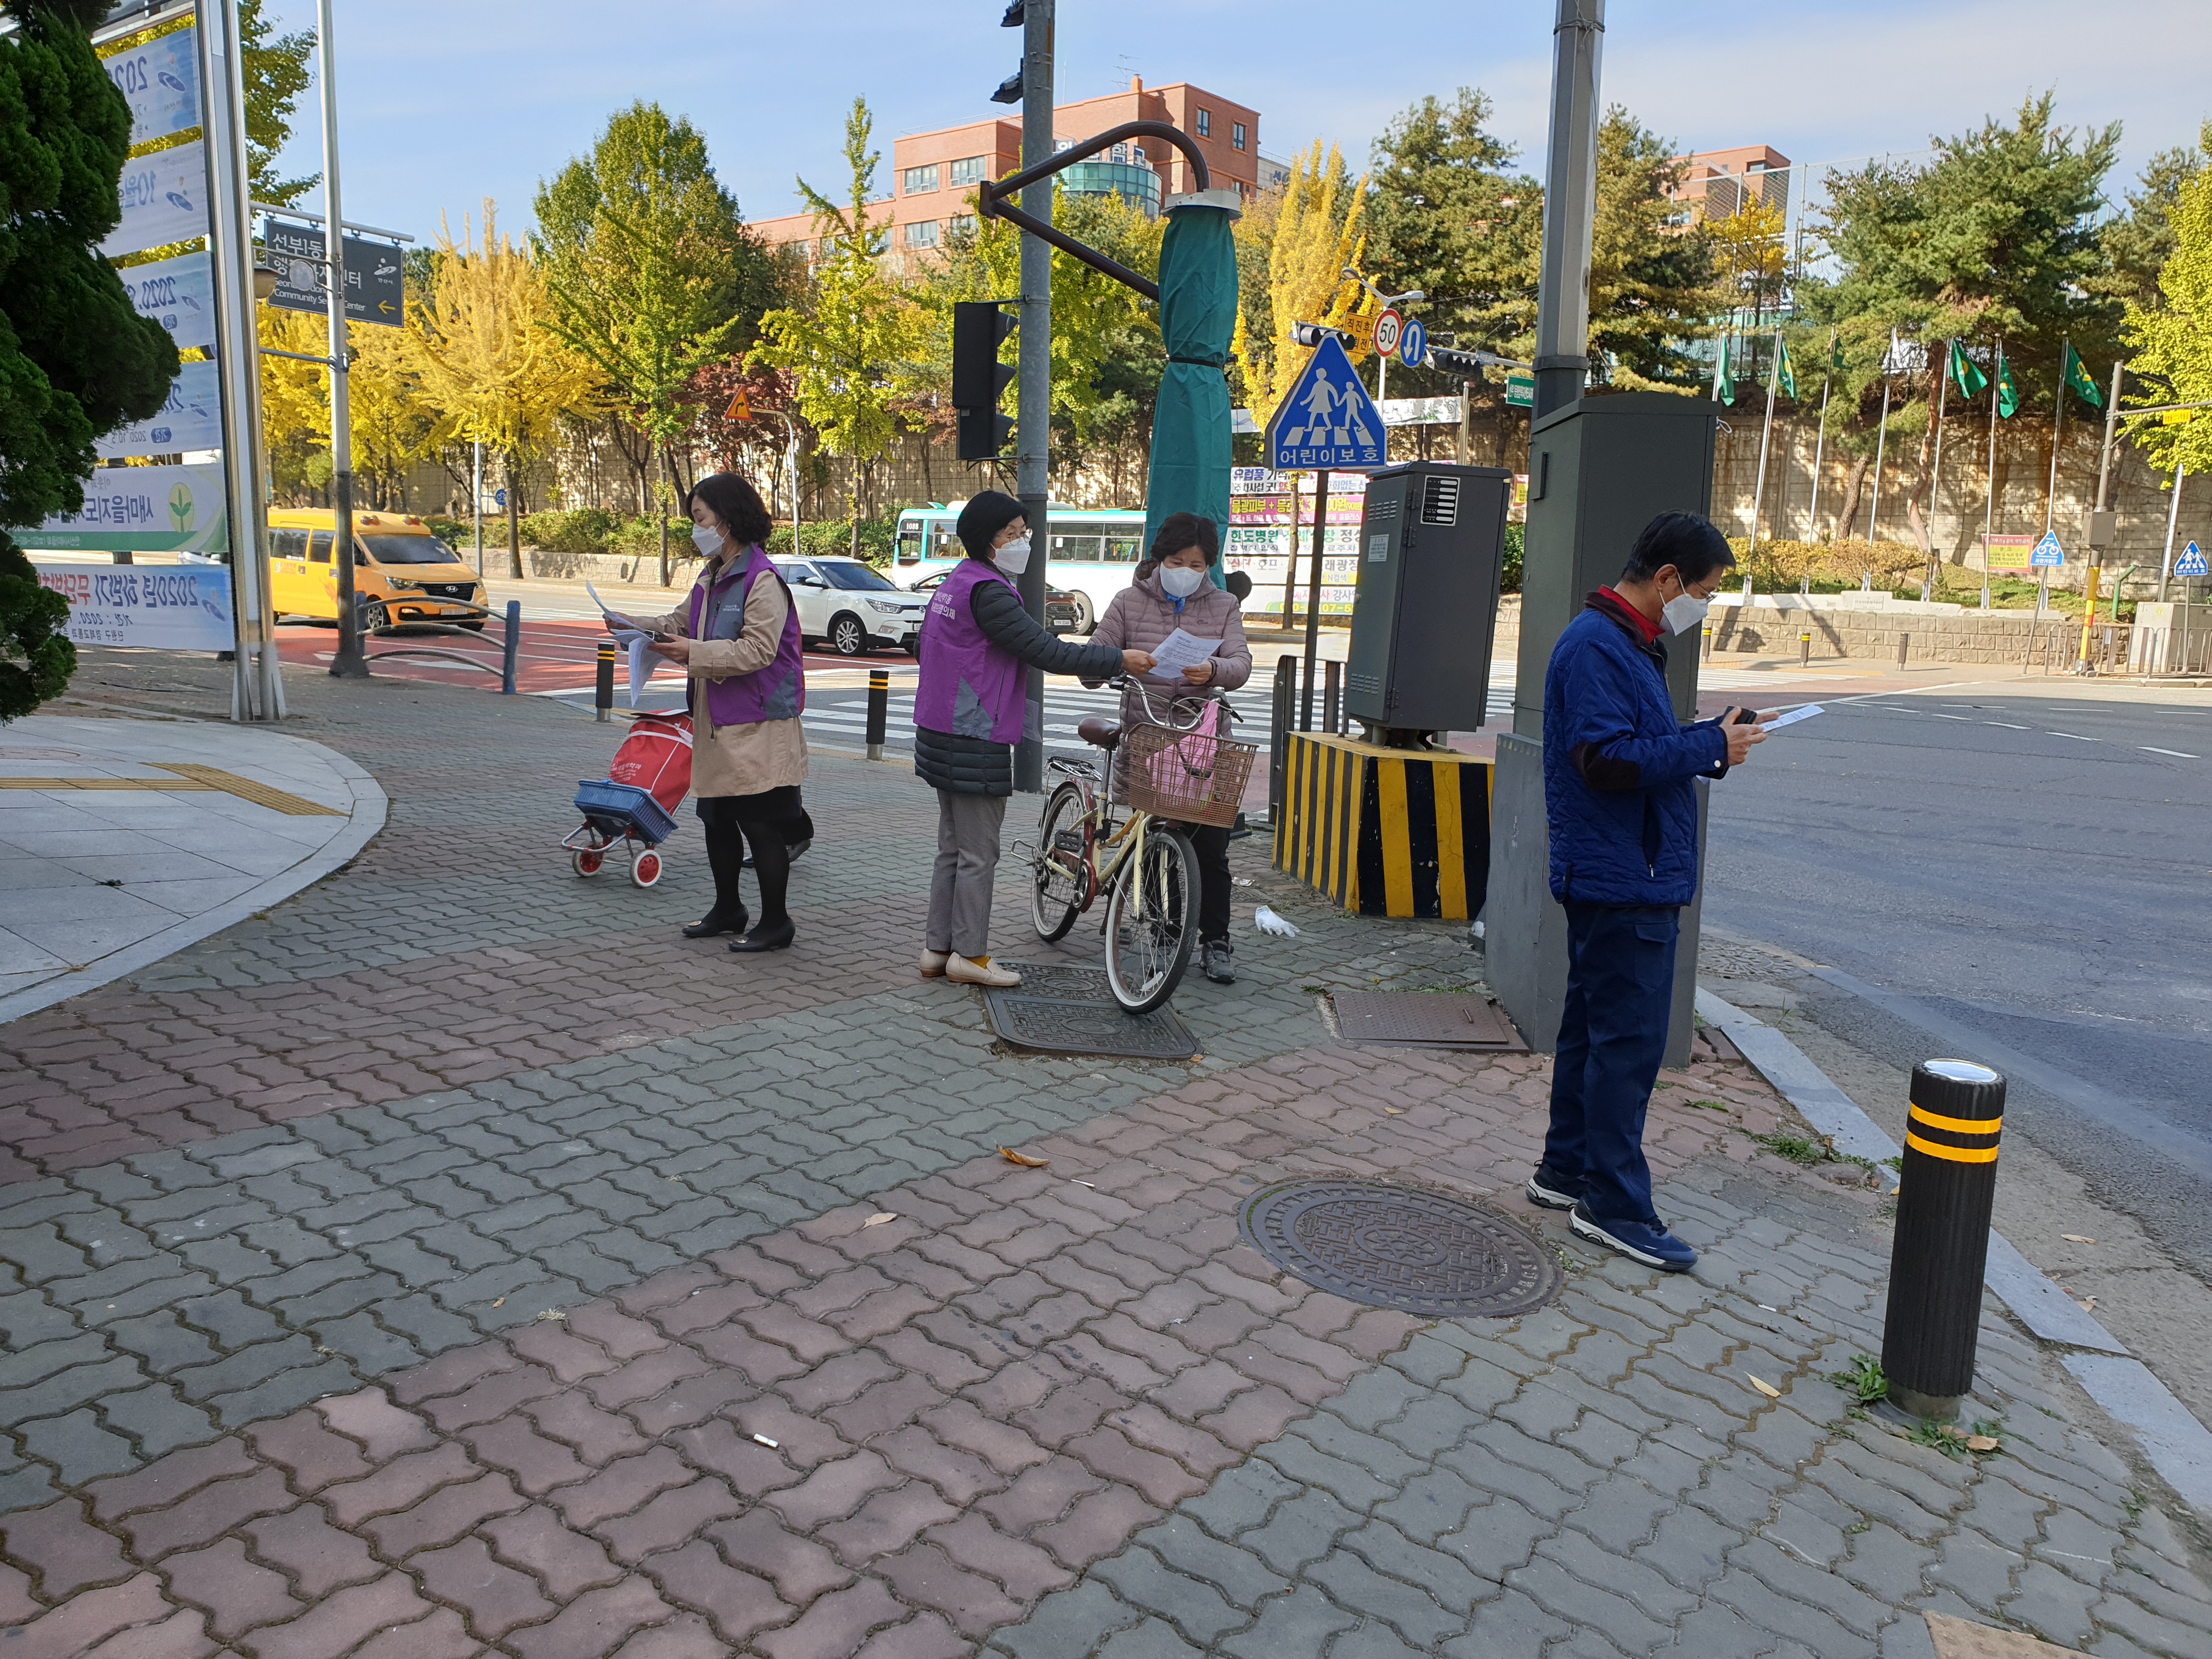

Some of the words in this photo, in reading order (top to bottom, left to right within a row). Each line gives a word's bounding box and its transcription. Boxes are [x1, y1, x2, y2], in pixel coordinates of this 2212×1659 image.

[274, 287, 317, 305] Community
[1347, 318, 1370, 334] 직진후
[1379, 323, 1396, 345] 50
[1280, 447, 1380, 465] 어린이보호
[1233, 468, 1265, 481] 유럽풍
[1231, 499, 1267, 514] 물광피부
[1230, 529, 1279, 543] 한도병원
